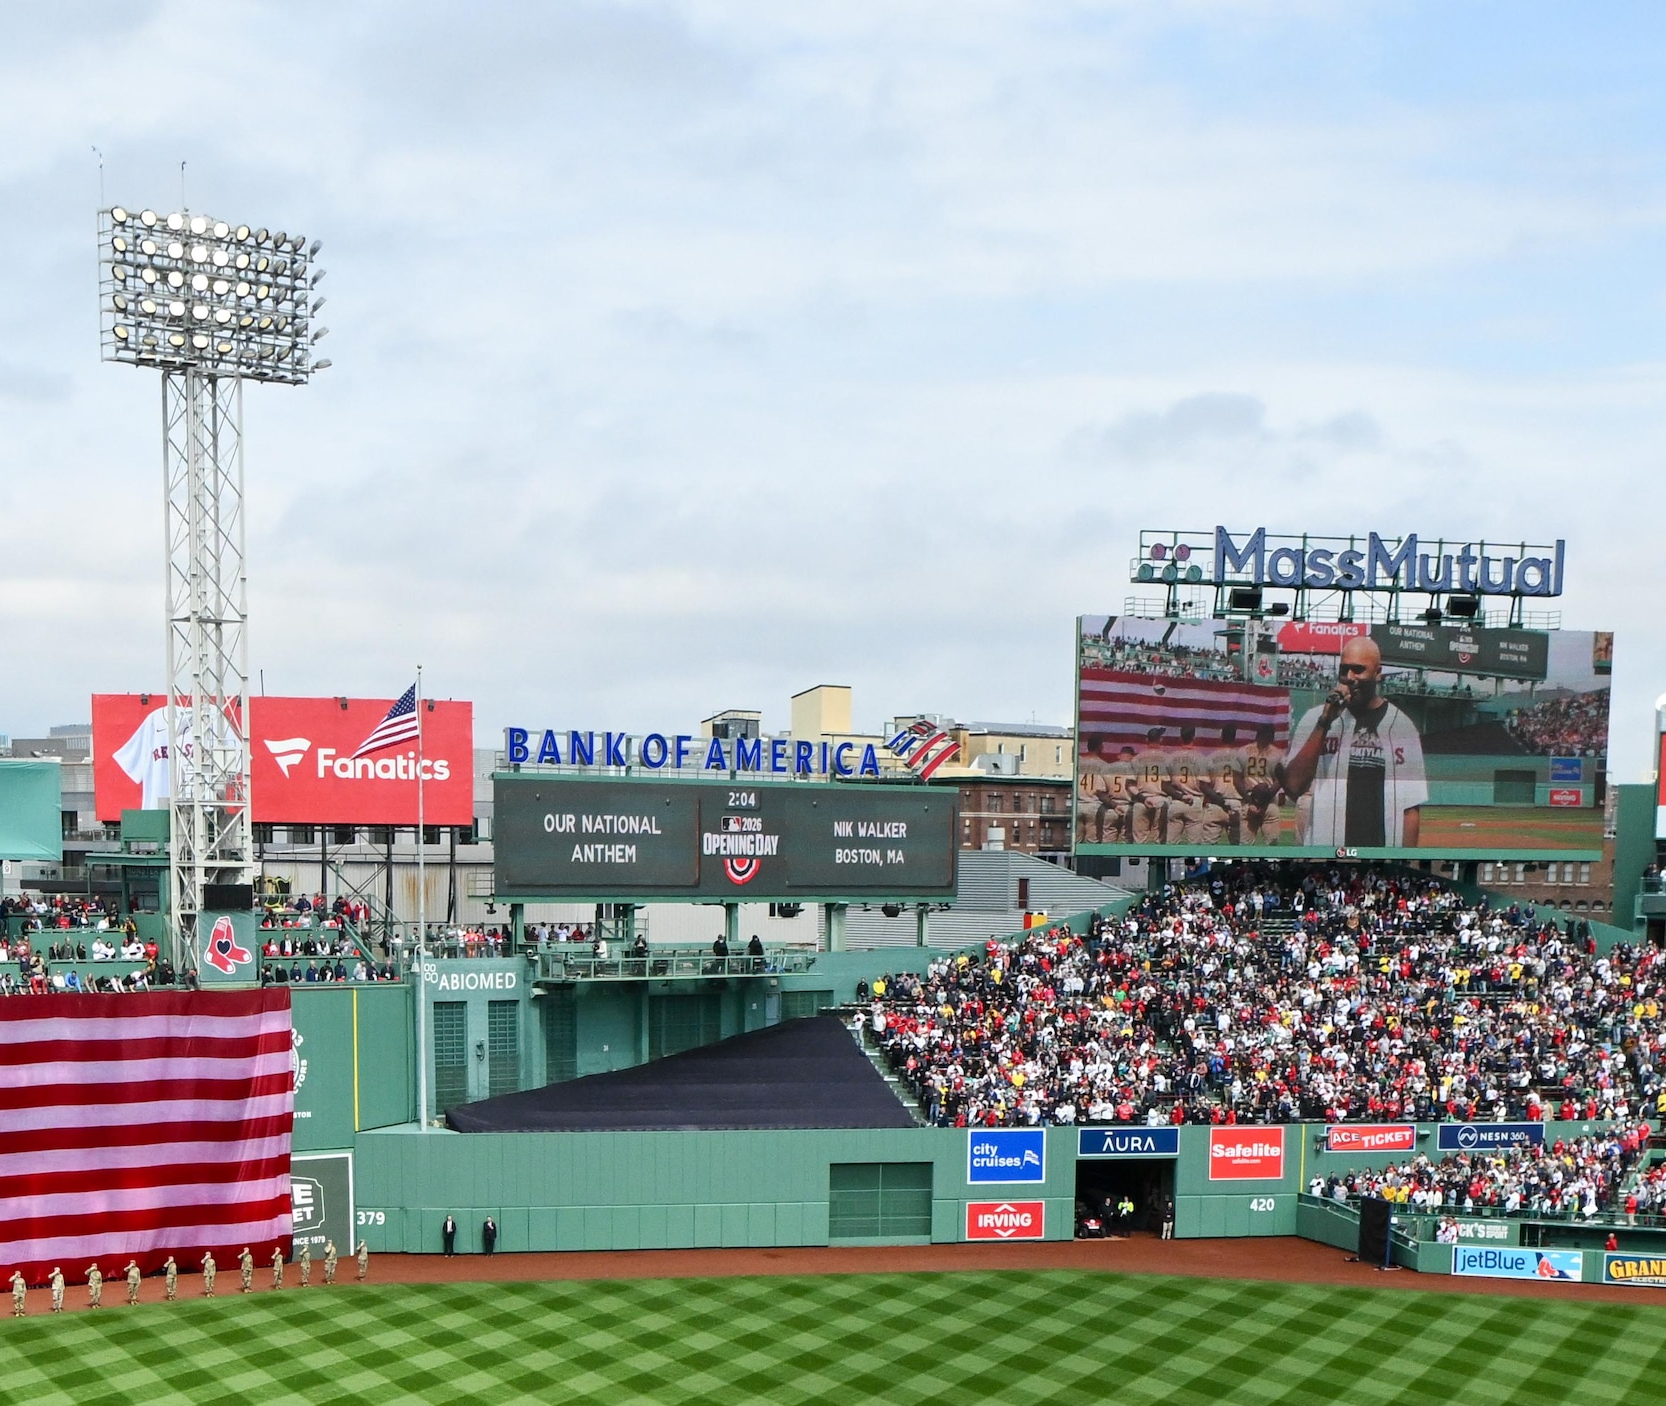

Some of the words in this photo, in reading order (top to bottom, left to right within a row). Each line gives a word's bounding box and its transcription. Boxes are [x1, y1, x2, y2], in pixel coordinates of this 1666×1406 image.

[1214, 525, 1565, 597] MassMutual
[1309, 622, 1358, 637] Fanatics
[506, 726, 629, 766] BANK
[642, 733, 692, 769] OF
[704, 737, 881, 777] AMERICA
[317, 747, 451, 782] Fanatics
[1247, 756, 1267, 777] 23
[1144, 765, 1160, 783] 13
[728, 791, 756, 807] 2:04
[543, 814, 576, 834] OUR
[581, 814, 663, 836] NATIONAL
[742, 817, 763, 832] 2026
[833, 820, 854, 837] NIK
[856, 821, 907, 838] WALKER
[572, 844, 637, 864] ANTHEM
[835, 848, 884, 867] BOSTON,
[886, 849, 905, 865] MA
[1346, 848, 1357, 857] LG
[438, 971, 517, 991] ABIOMED
[1332, 1131, 1361, 1144] ACE
[1361, 1130, 1412, 1148] TICKET
[1479, 1131, 1508, 1142] NESN
[1510, 1131, 1526, 1142] 360
[973, 1143, 998, 1158] city
[1211, 1142, 1282, 1158] Safelite
[973, 1156, 1021, 1168] cruises
[1249, 1198, 1275, 1212] 420
[356, 1211, 386, 1226] 379
[978, 1213, 1033, 1229] IRVING
[1461, 1250, 1526, 1273] jetBlue
